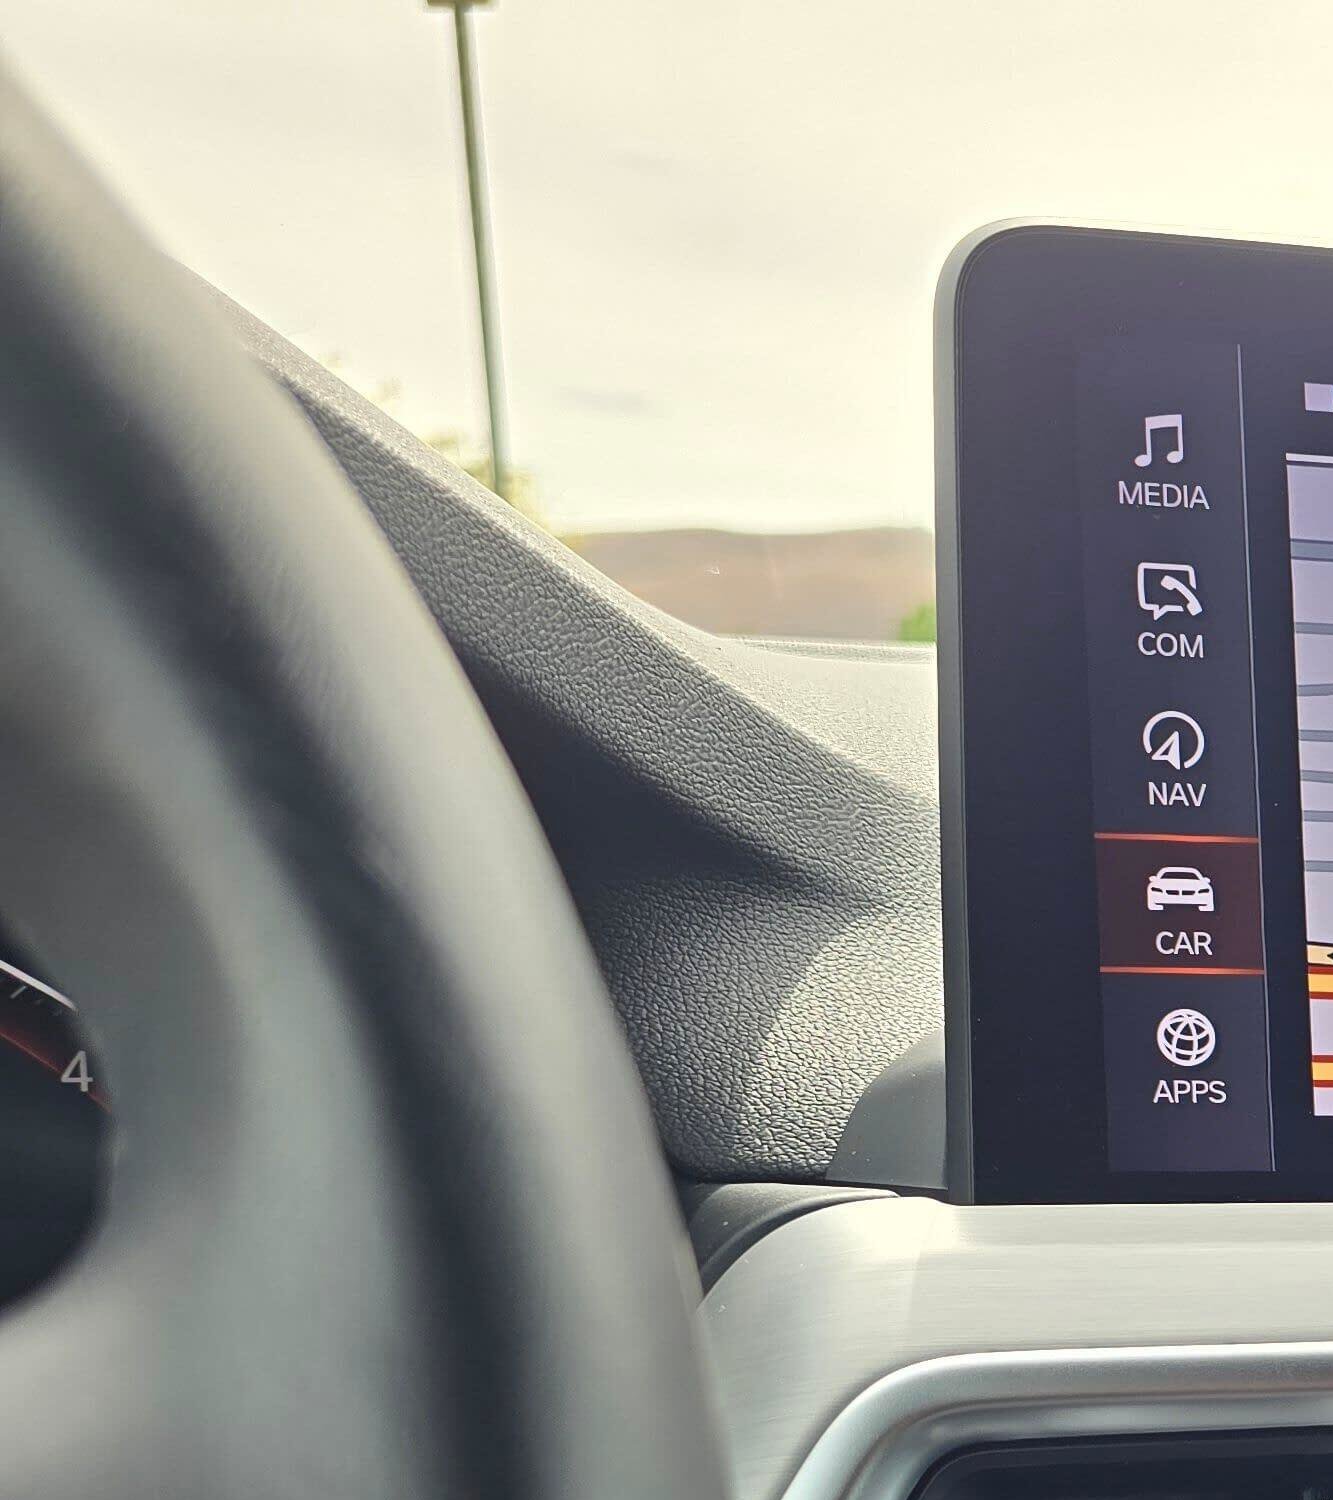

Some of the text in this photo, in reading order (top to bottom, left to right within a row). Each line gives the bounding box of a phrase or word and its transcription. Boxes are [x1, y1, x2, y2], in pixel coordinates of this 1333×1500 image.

[1117, 480, 1210, 510] MEDIA
[1137, 631, 1204, 659] COM
[1148, 781, 1207, 808] NAV
[1155, 930, 1212, 957] CAR
[61, 1050, 93, 1092] 4
[1153, 1079, 1227, 1105] APPS
